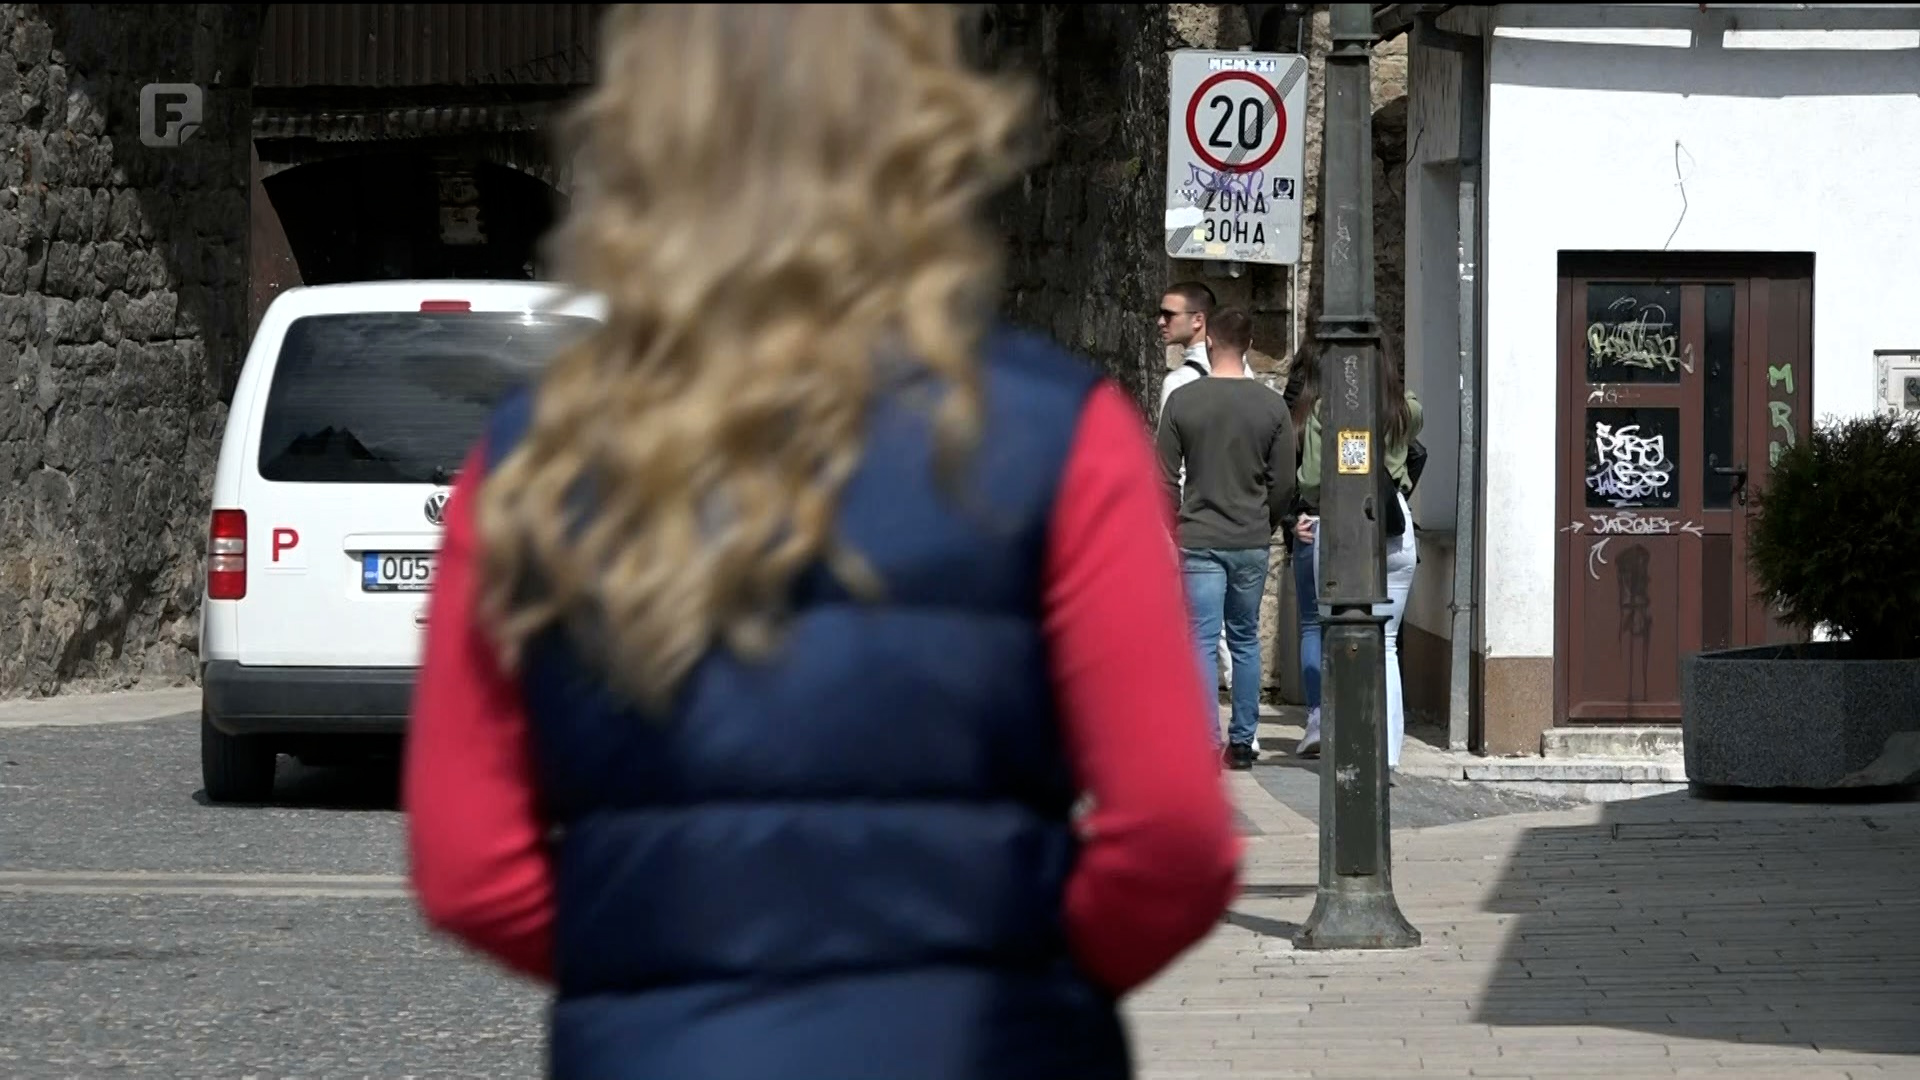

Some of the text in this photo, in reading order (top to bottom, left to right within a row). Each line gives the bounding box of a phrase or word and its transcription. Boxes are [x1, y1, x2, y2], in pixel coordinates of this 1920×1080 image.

[1208, 95, 1264, 150] 20
[1204, 189, 1266, 214] ZONA
[272, 528, 299, 562] P
